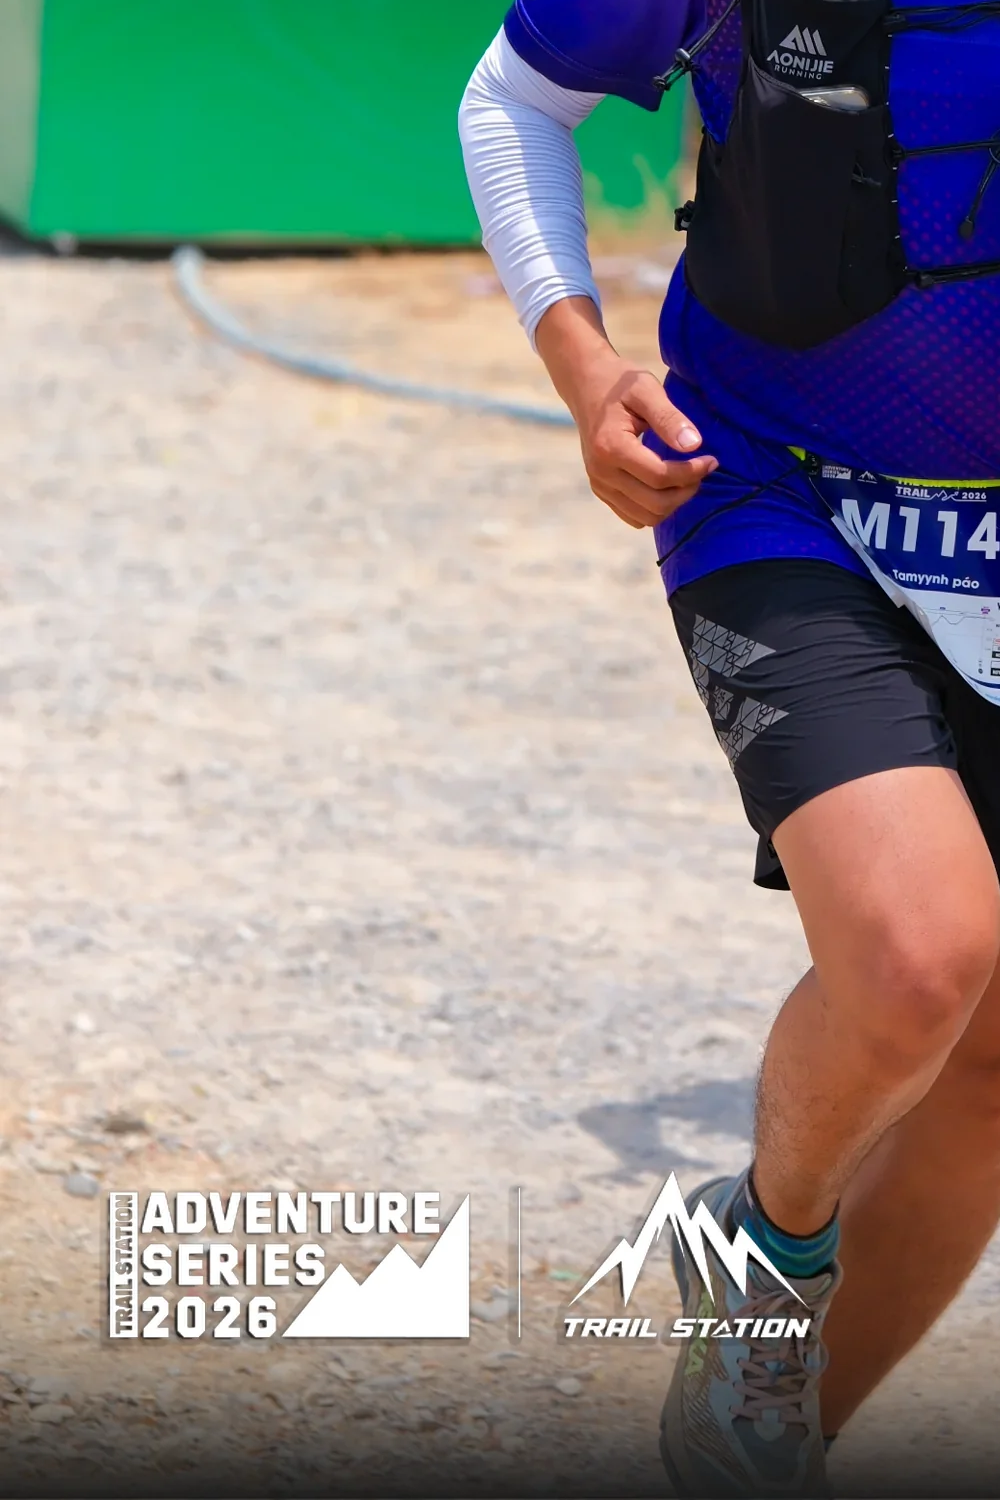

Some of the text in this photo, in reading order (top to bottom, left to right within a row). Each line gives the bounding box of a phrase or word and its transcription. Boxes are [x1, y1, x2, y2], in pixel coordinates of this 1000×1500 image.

[766, 49, 834, 74] AONIJIE
[774, 64, 822, 80] RUNNING
[895, 486, 987, 500] TRAIL 2026
[892, 569, 980, 590] Tamyynh páo
